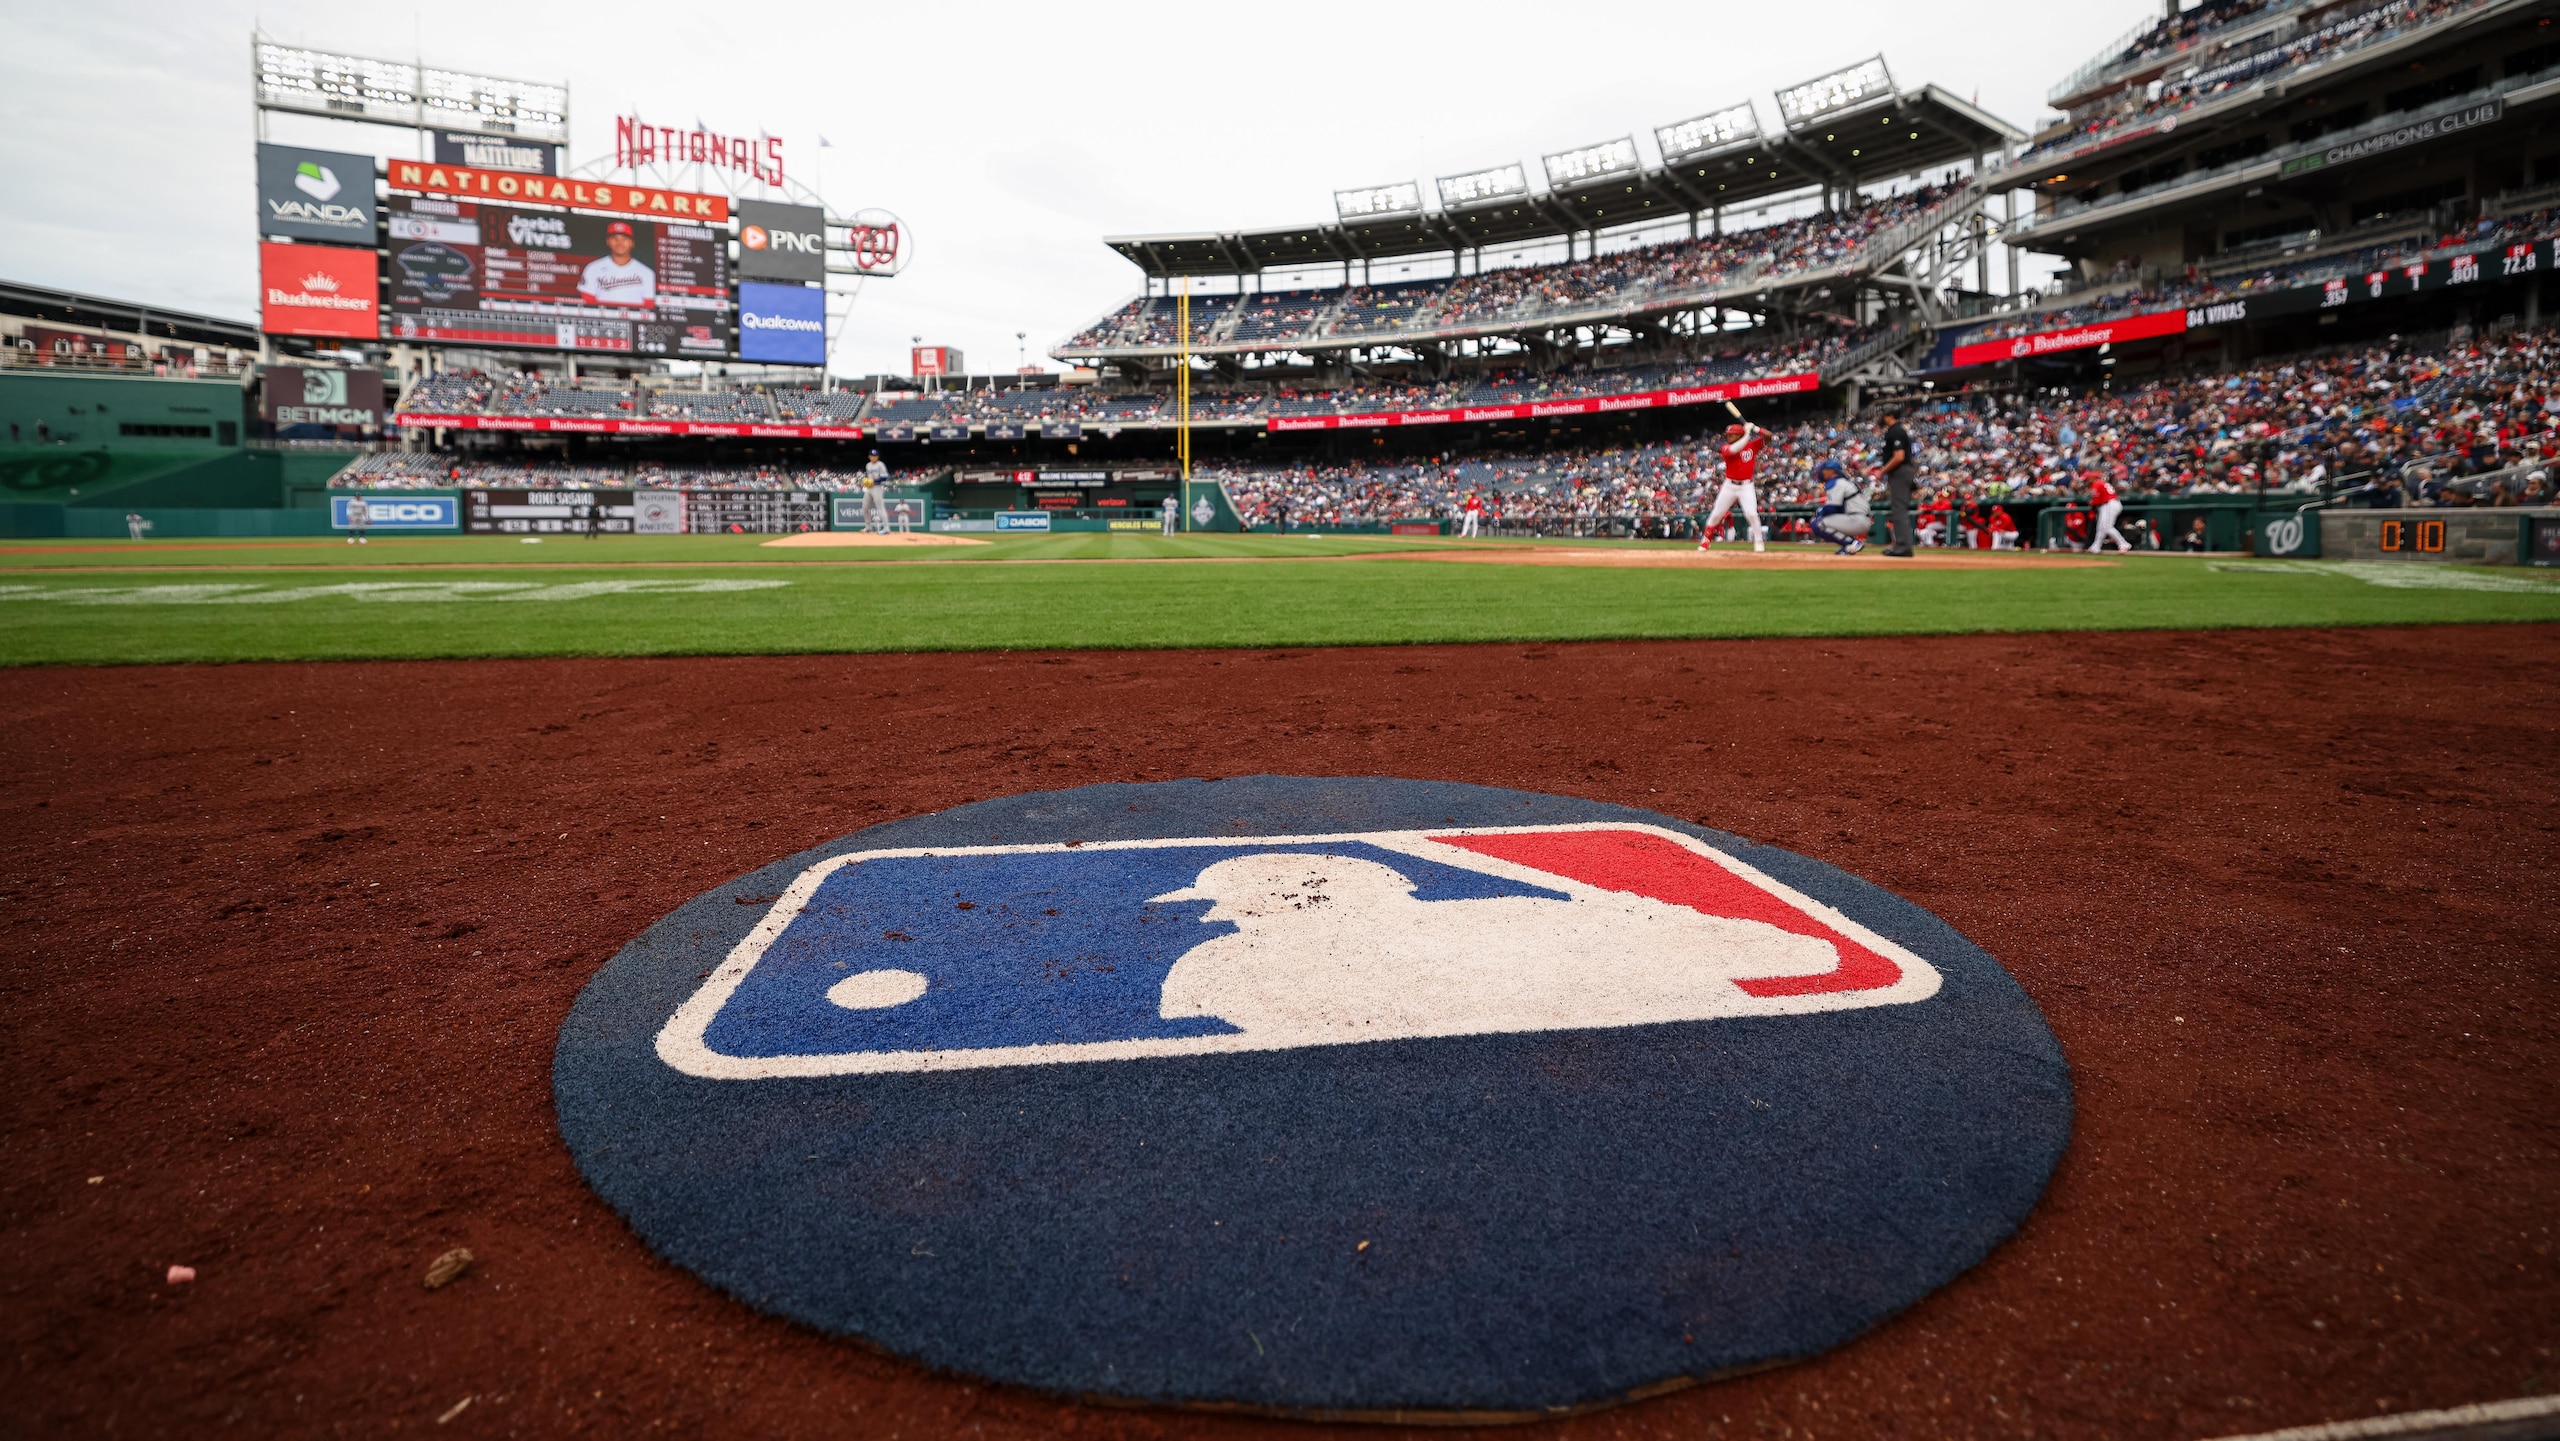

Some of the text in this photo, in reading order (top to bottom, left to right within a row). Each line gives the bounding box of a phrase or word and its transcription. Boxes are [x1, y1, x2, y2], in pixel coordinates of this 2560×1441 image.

[2326, 120, 2436, 164] CHAMPIONS
[2439, 105, 2495, 133] CLUB
[463, 144, 544, 169] NATITUDE
[617, 114, 783, 188] NATIONALS
[400, 164, 715, 217] NATIONALS PARK
[268, 198, 369, 223] VANDA
[510, 214, 567, 233] Jorbit
[667, 224, 716, 242] NATIONALS
[507, 227, 573, 249] Vivas
[768, 229, 824, 255] PNC
[268, 288, 372, 312] Budweiser
[2186, 309, 2205, 328] 84
[2206, 301, 2247, 325] VIVAS
[2411, 276, 2420, 291] 1
[2446, 263, 2479, 286] .801
[2502, 252, 2537, 276] 72.8
[742, 312, 823, 332] Qualcomm
[2033, 327, 2114, 351] Budweiser
[276, 406, 374, 424] BETMGM
[1277, 380, 1801, 430] Budweiser Budweiser Budweiser Budweiser Budweiser Budweiser Budweiser Budweiser
[401, 416, 858, 439] Budweiser Budweiser Budweiser Budweiser Budweiser Budweiser Budweiser
[528, 491, 554, 505] ROKI
[555, 491, 595, 505] SASAKI
[1097, 497, 1127, 507] verizon
[346, 503, 443, 522] EICO
[1009, 518, 1048, 527] DABOS
[1109, 521, 1163, 530] HERCULES FENCE
[2265, 513, 2304, 555] W
[2382, 519, 2446, 552] 0:10
